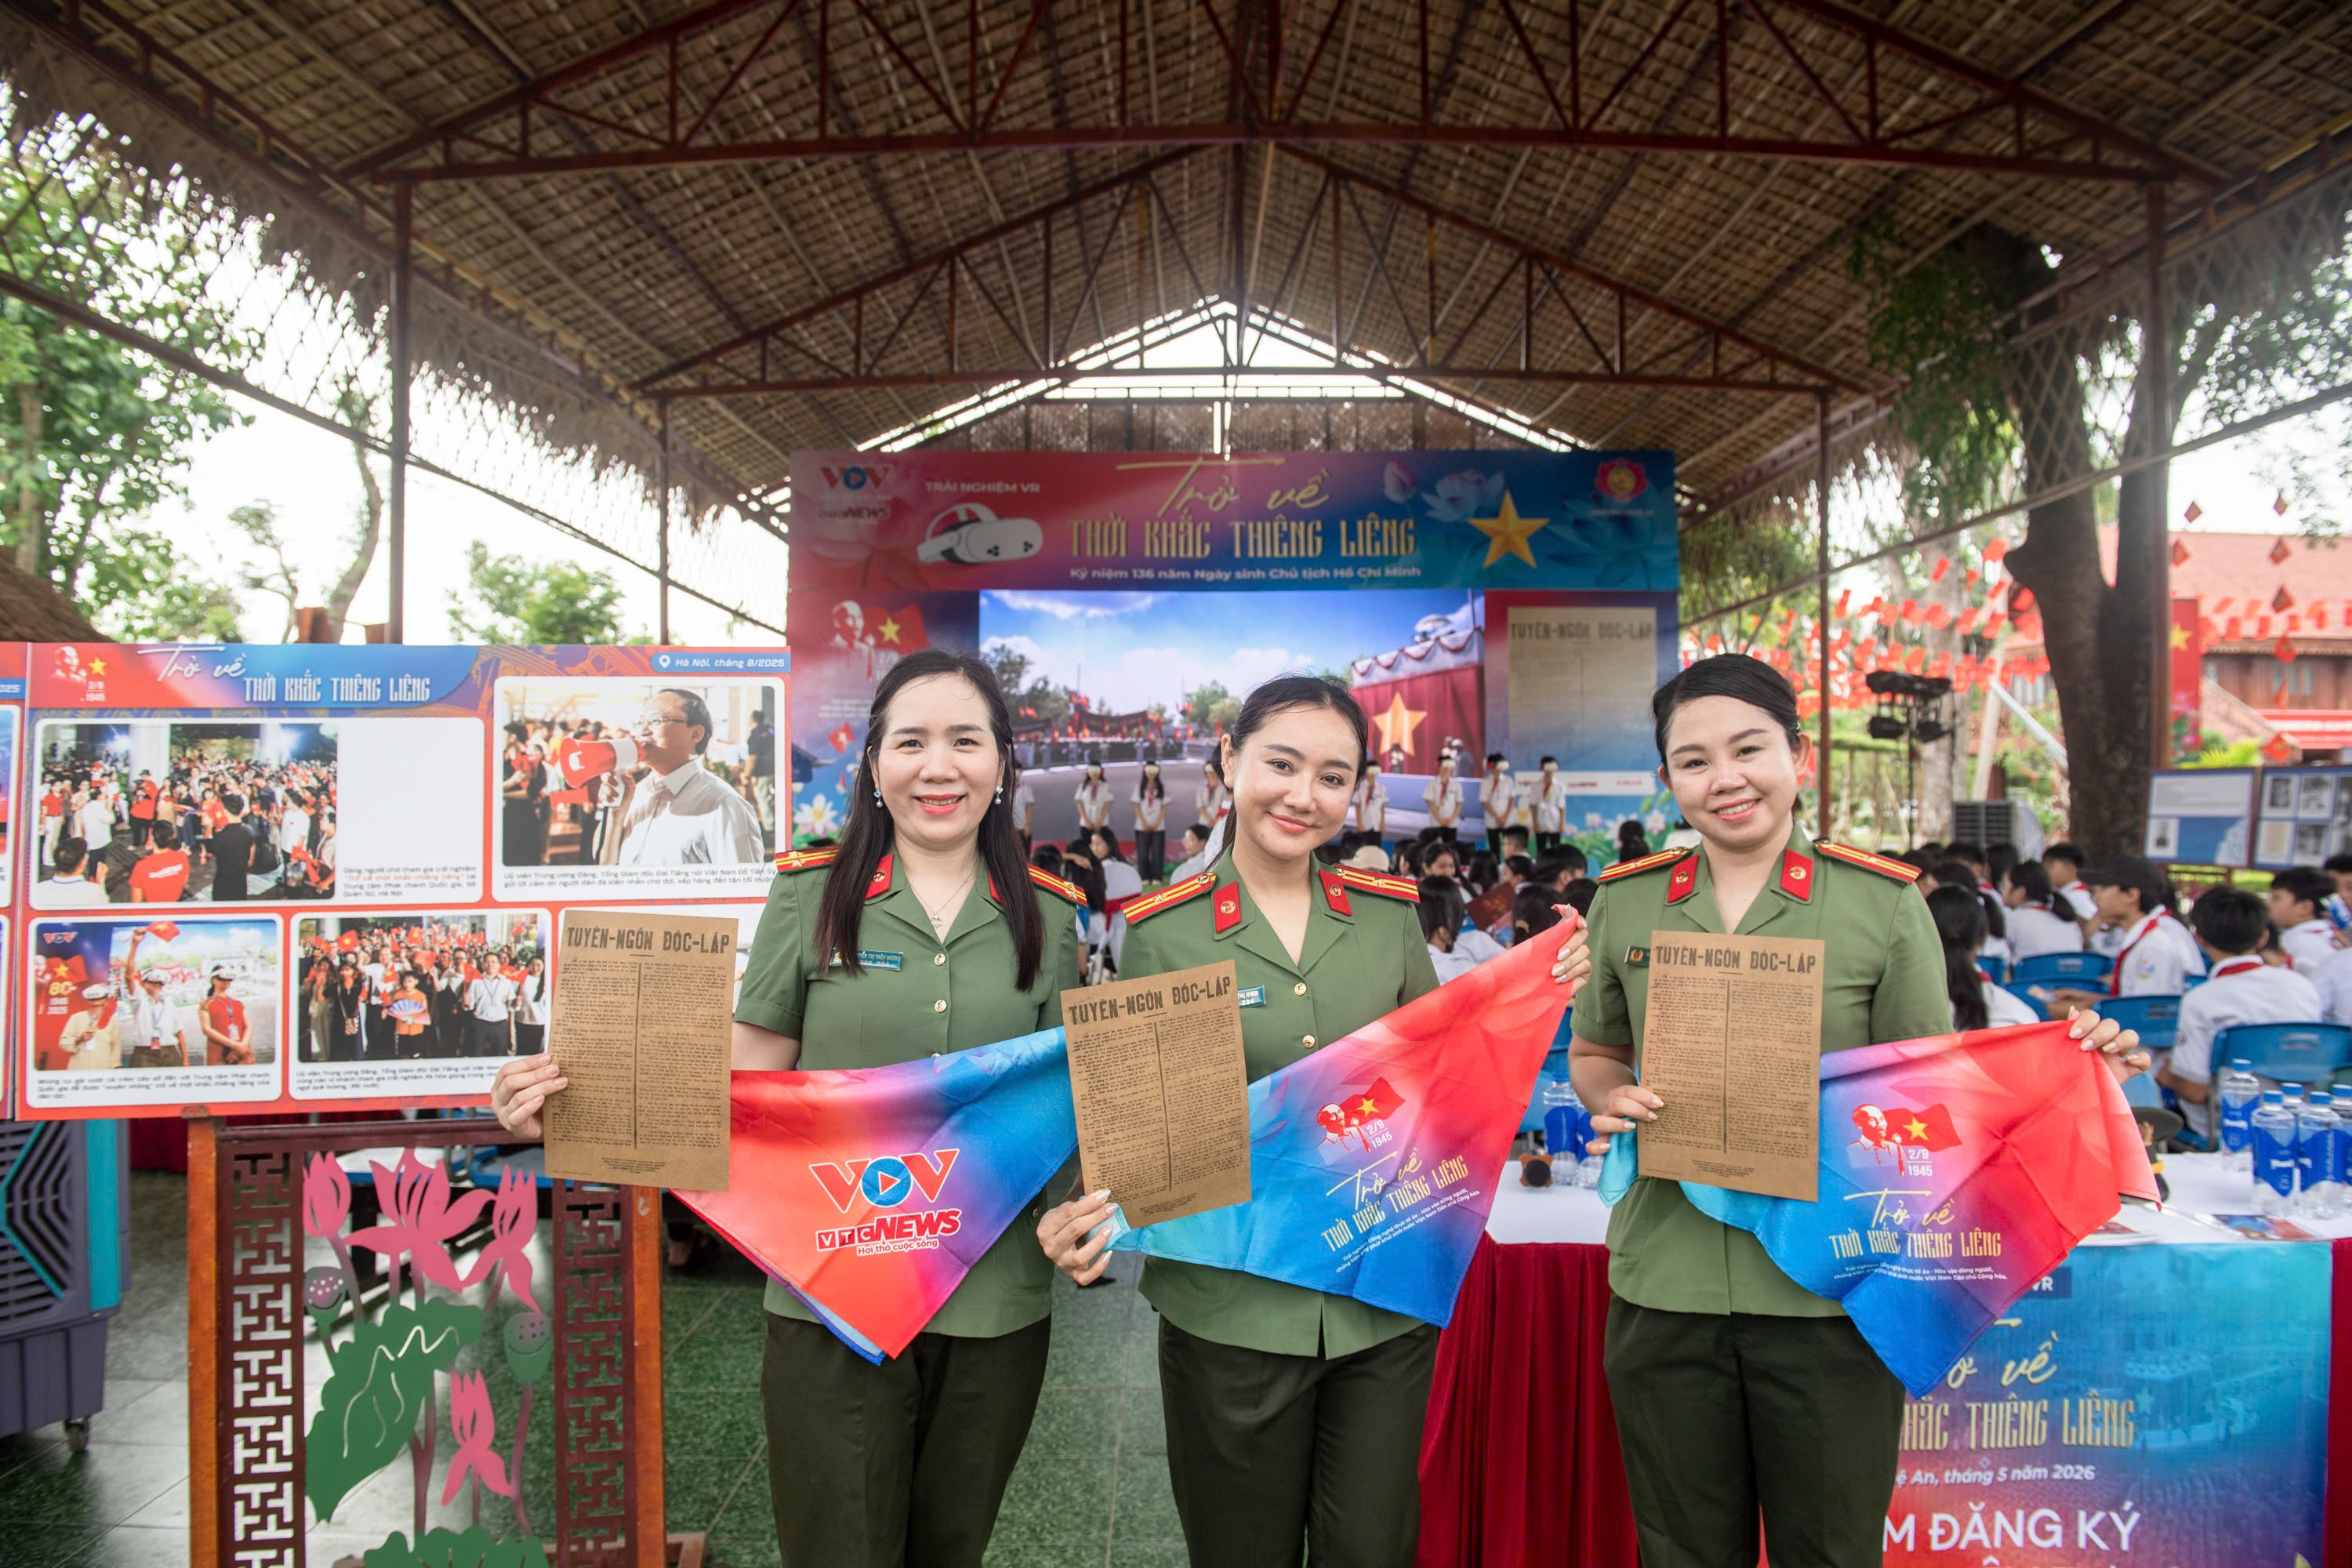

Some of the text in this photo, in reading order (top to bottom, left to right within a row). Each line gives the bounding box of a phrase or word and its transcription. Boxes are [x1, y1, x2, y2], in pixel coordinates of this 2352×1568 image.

[820, 465, 891, 490] VOV
[926, 479, 1040, 494] TRẢI NGHIỆM VR
[1116, 456, 1330, 517] Trở về
[1068, 508, 1417, 559] THỜI KHẮC THIÊNG LIÊNG
[1091, 568, 1128, 580] niệm
[1131, 568, 1156, 579] 136
[1158, 568, 1191, 579] năm
[1194, 568, 1231, 582] Ngày
[1235, 568, 1265, 579] sinh
[1269, 568, 1299, 580] Chủ
[1301, 567, 1330, 580] tịch
[1384, 566, 1421, 578] Minh
[137, 645, 248, 682] Trở về
[675, 659, 690, 667] Hà
[714, 659, 744, 669] tháng
[746, 659, 785, 667] 8/2025
[243, 669, 430, 702] THỜI KHẮC THIÊNG LIÊNG
[566, 926, 731, 954] TUYÊN-NGÔN ĐỘC-LẬP
[1655, 945, 1817, 974] TUYÊN-NGÔN ĐỘC-LẬP
[1068, 975, 1232, 1026] TUYÊN-NGÔN ĐỘC-LẬP
[1367, 1119, 1385, 1135] 2/9
[1371, 1131, 1392, 1149] 1945
[1907, 1164, 1933, 1177] 1945
[1908, 1149, 1929, 1160] 2/9
[808, 1148, 960, 1214] VOV
[1325, 1147, 1423, 1211] Trở về
[1320, 1154, 1468, 1252] THỜI KHẮC THIÊNG LIÊNG
[1381, 1234, 1393, 1243] khai
[1392, 1228, 1403, 1238] sinh
[1403, 1221, 1416, 1232] nước
[1414, 1215, 1426, 1224] Việt
[1425, 1210, 1438, 1218] Nam
[1436, 1203, 1448, 1212] Dân
[1456, 1194, 1470, 1203] Cộng
[1843, 1187, 1955, 1229] Trở về
[858, 1237, 938, 1255] Hơi thở cuộc sống
[1367, 1234, 1382, 1243] Công
[1828, 1223, 2002, 1260] THỜI KHẮC THIÊNG LIÊNG
[2000, 1330, 2060, 1387] về
[1899, 1388, 2136, 1451] HẮC THIÊNG LIÊNG
[1911, 1468, 1939, 1486] An,
[1944, 1465, 1994, 1487] tháng
[1997, 1467, 2008, 1483] 5
[2011, 1465, 2048, 1482] năm
[2052, 1464, 2096, 1481] 2026
[1929, 1501, 2063, 1551] ĐĂNG
[2076, 1501, 2141, 1552] KÝ
